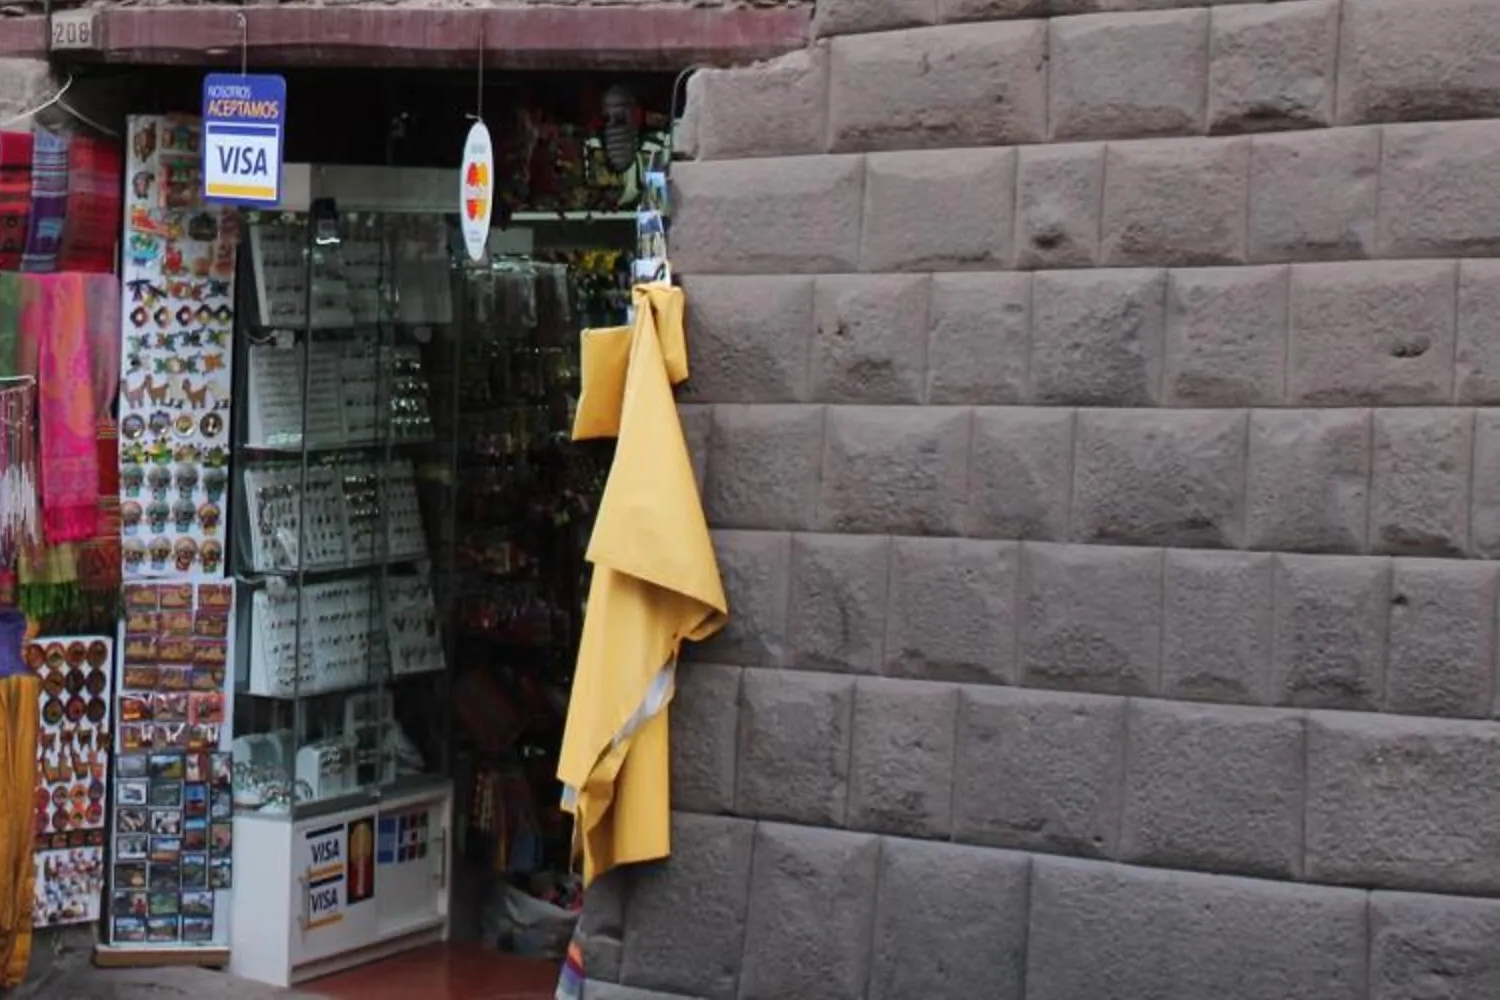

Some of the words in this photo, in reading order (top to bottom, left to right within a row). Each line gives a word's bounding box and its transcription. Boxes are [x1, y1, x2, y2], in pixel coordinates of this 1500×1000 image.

[207, 85, 251, 98] NOSOTROS
[207, 99, 279, 119] ACEPTAMOS
[216, 145, 267, 176] VISA
[311, 838, 340, 865] VISA
[309, 888, 338, 914] VISA
